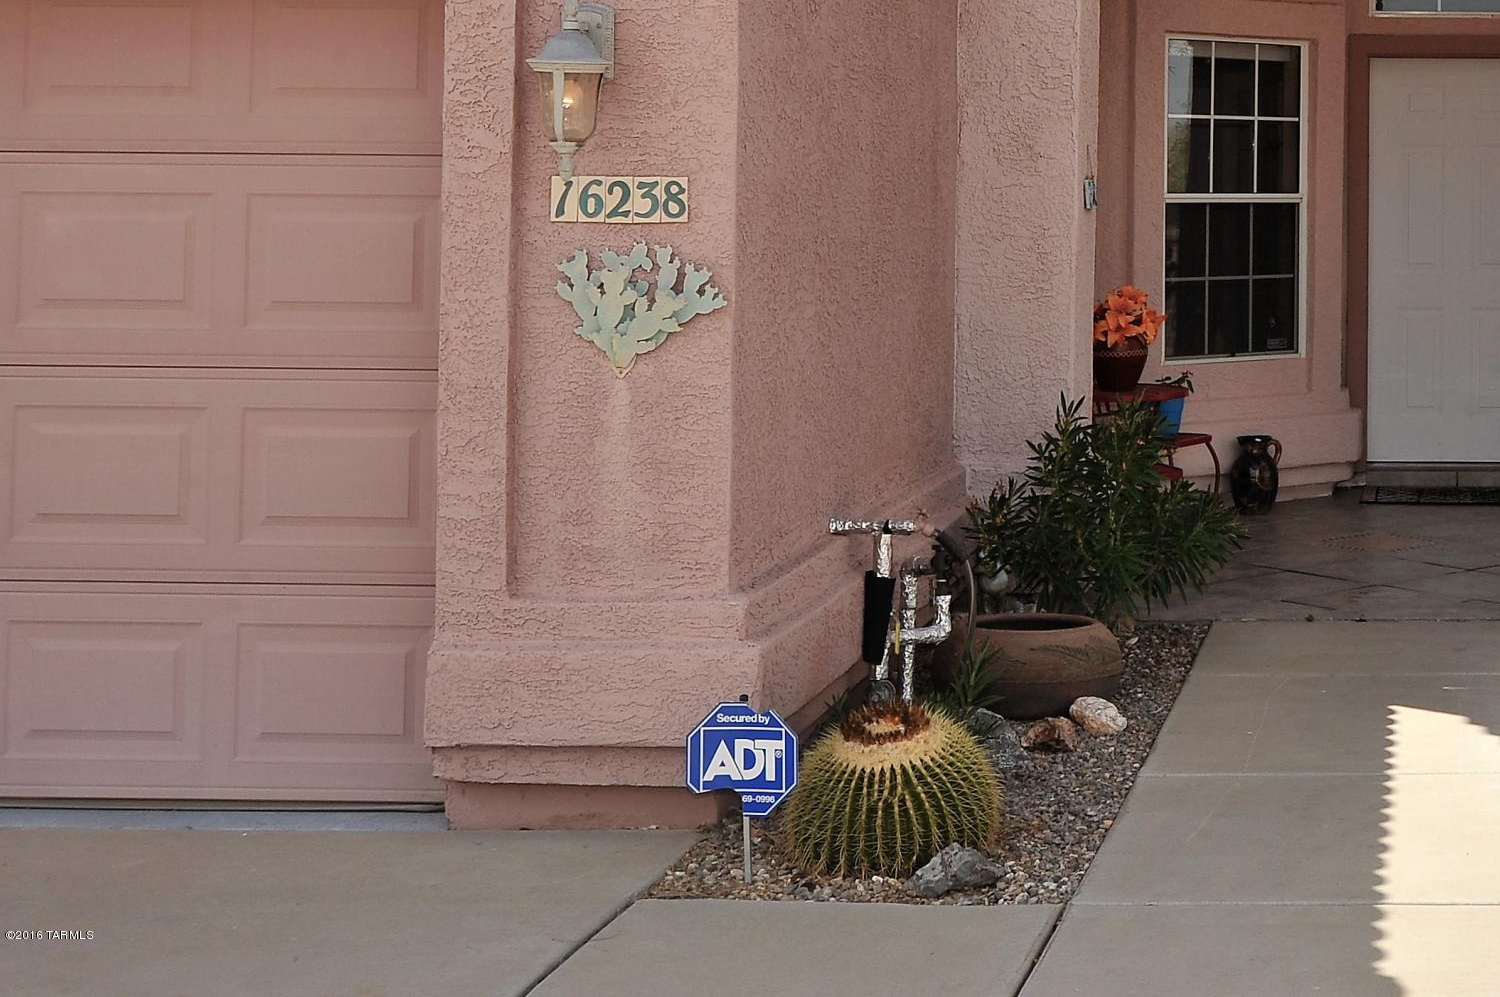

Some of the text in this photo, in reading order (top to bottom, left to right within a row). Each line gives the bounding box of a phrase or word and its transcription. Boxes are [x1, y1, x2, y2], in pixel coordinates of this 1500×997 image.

[555, 179, 686, 219] 16238
[716, 713, 770, 725] Secured by
[703, 739, 784, 781] ADT
